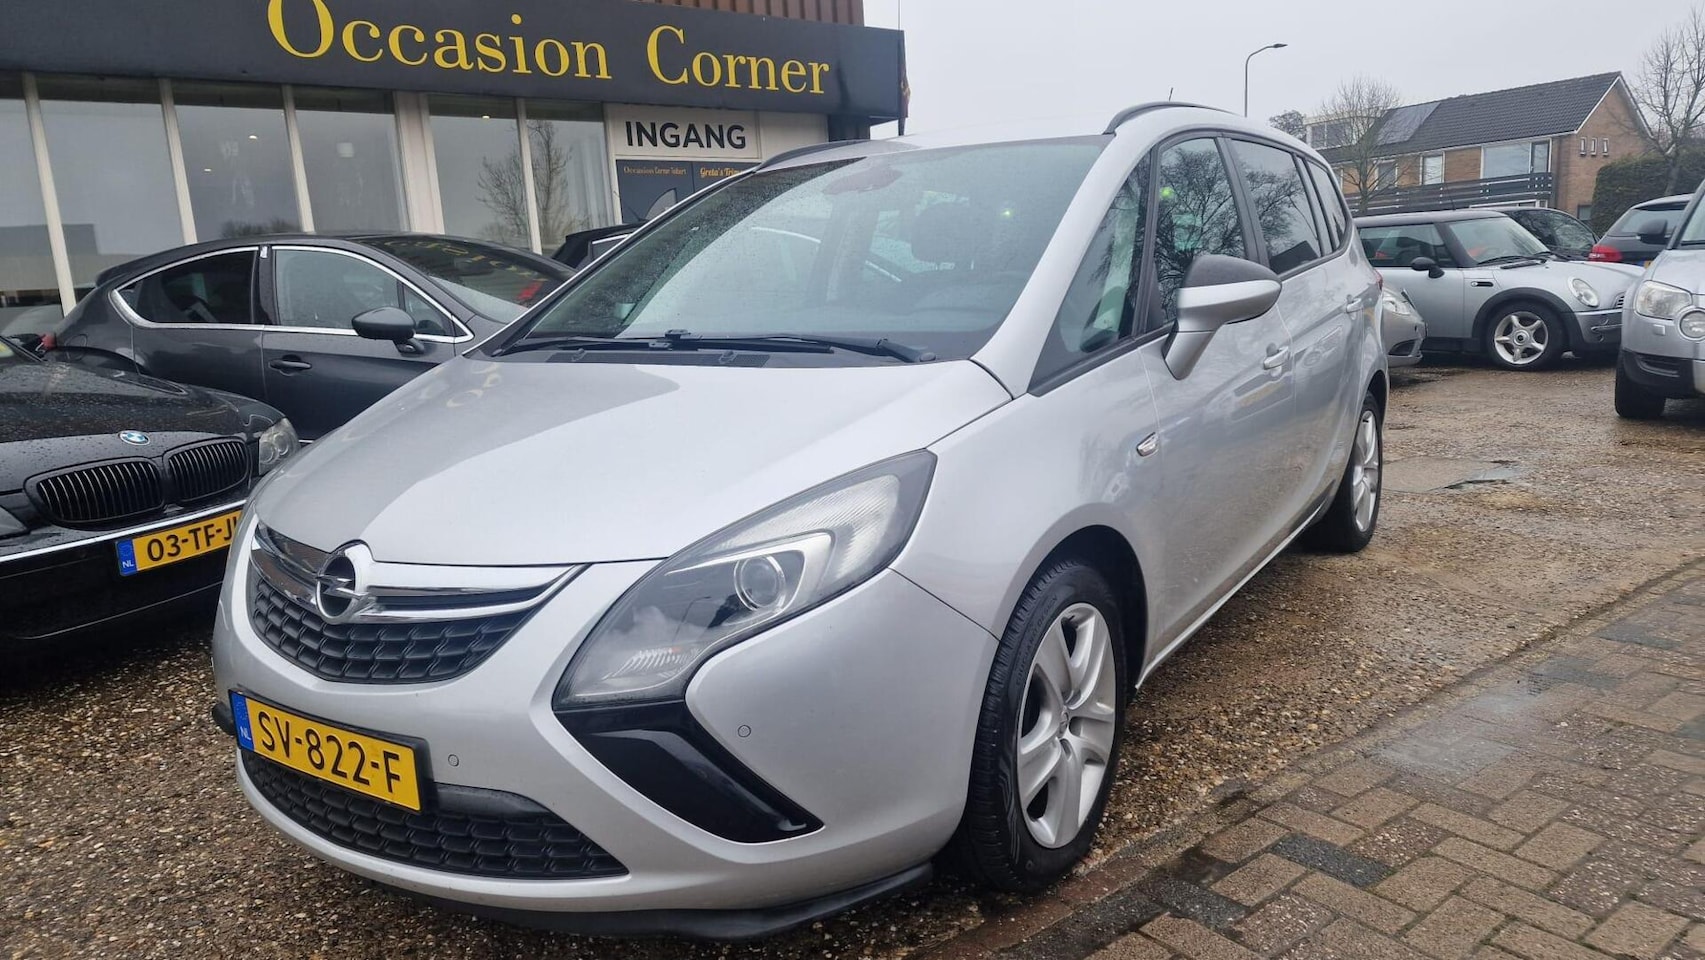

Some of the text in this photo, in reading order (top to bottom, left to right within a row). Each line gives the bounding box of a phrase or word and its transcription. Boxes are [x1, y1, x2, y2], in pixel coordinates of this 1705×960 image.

[267, 0, 830, 95] Occasion Corner
[625, 121, 746, 149] INGANG
[122, 560, 134, 568] NL
[240, 727, 252, 741] NL
[257, 710, 401, 794] SV-822-F
